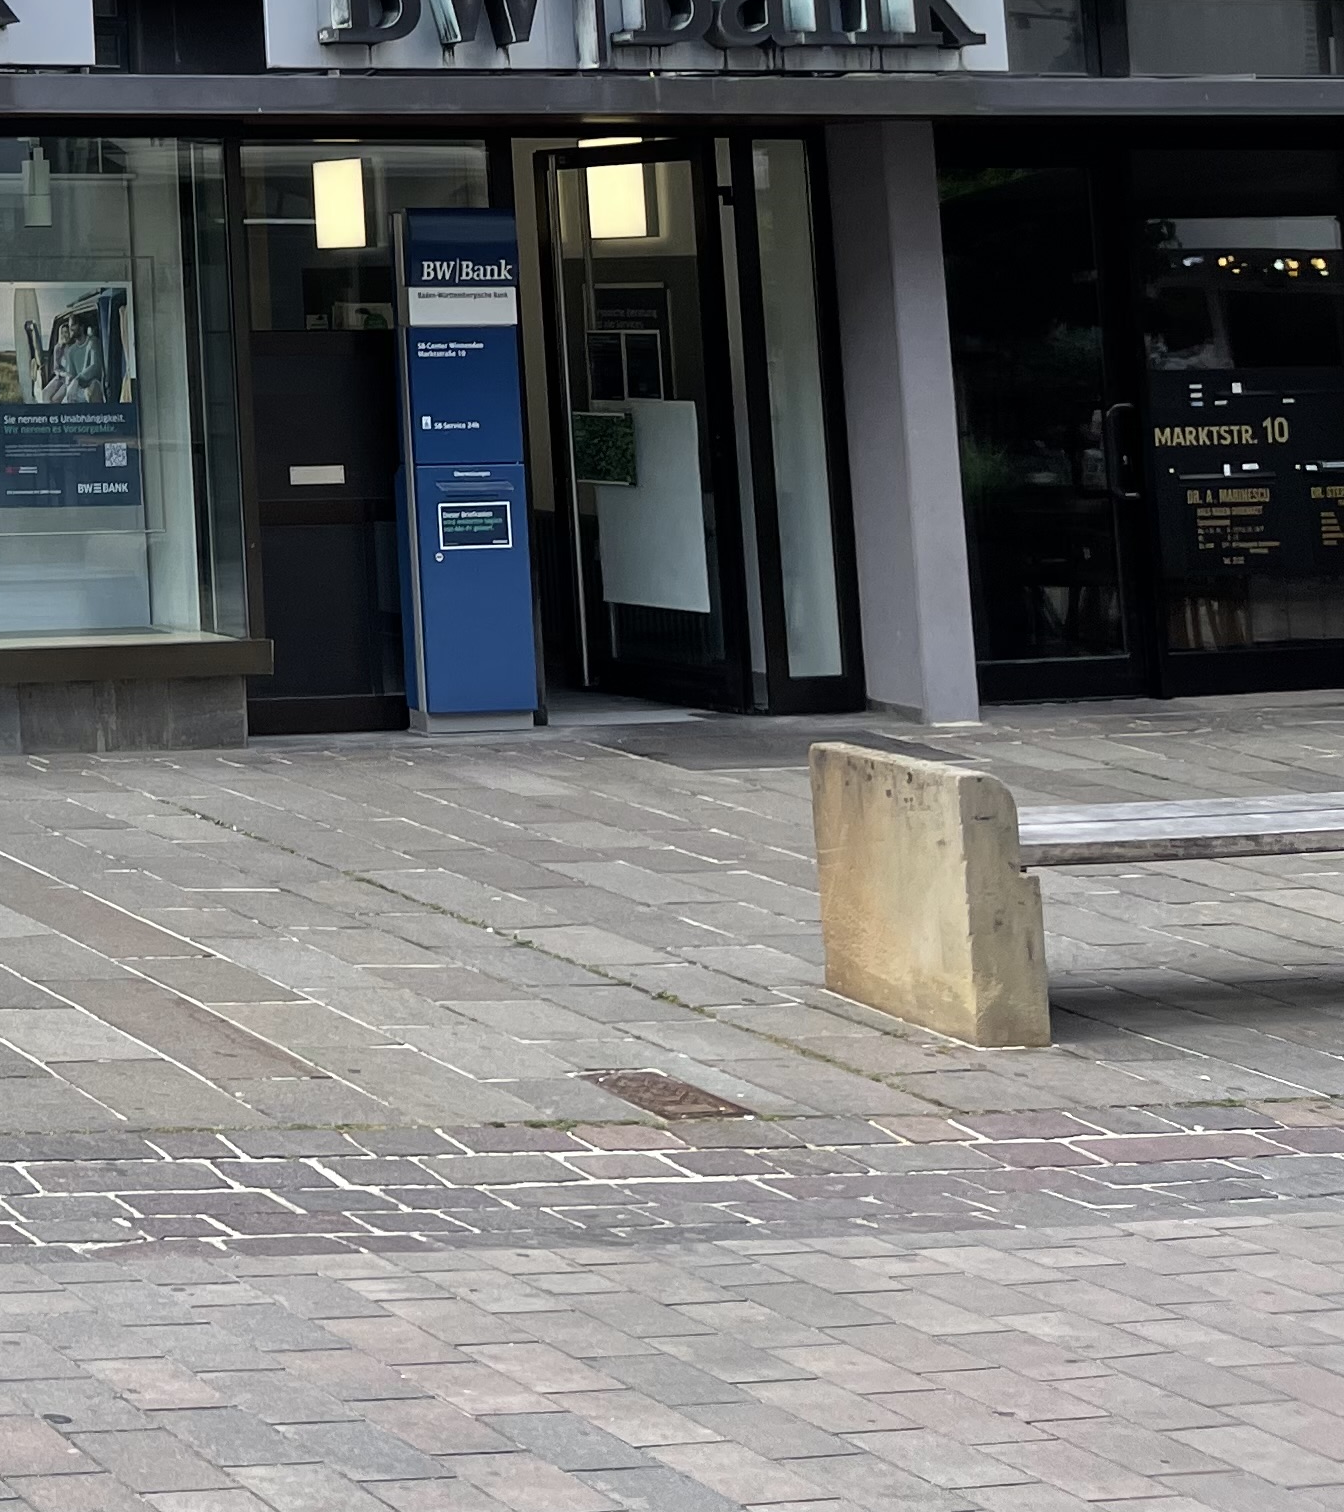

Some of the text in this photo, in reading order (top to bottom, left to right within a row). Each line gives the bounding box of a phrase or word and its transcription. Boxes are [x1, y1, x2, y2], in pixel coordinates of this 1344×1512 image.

[3, 414, 17, 425] Sie
[49, 415, 59, 424] es
[1154, 416, 1290, 447] MARKTSTR. 10
